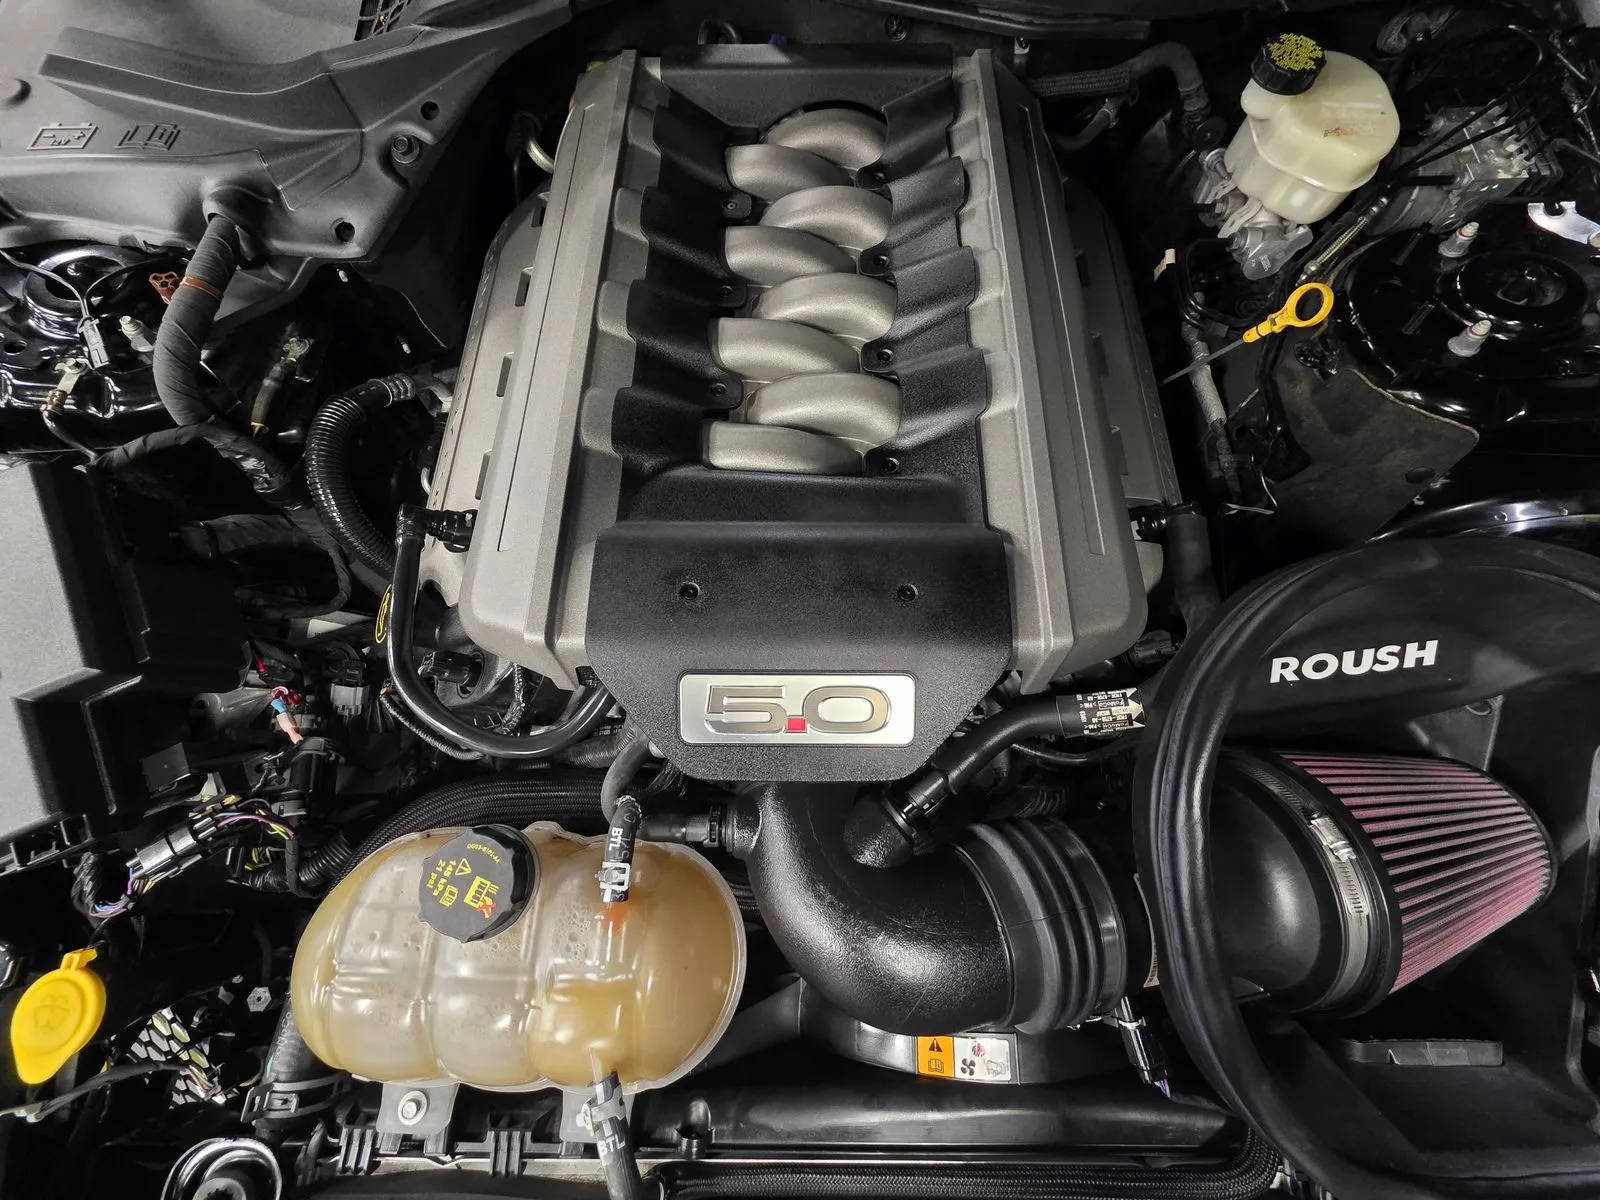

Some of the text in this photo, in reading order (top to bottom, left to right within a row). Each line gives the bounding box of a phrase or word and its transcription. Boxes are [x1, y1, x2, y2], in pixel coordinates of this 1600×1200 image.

[1269, 640, 1439, 684] ROUSH
[704, 684, 892, 735] 5.0
[608, 827, 624, 851] BTL
[433, 860, 456, 896] 145 kPa
[435, 859, 446, 872] 21
[596, 1134, 626, 1157] BTL
